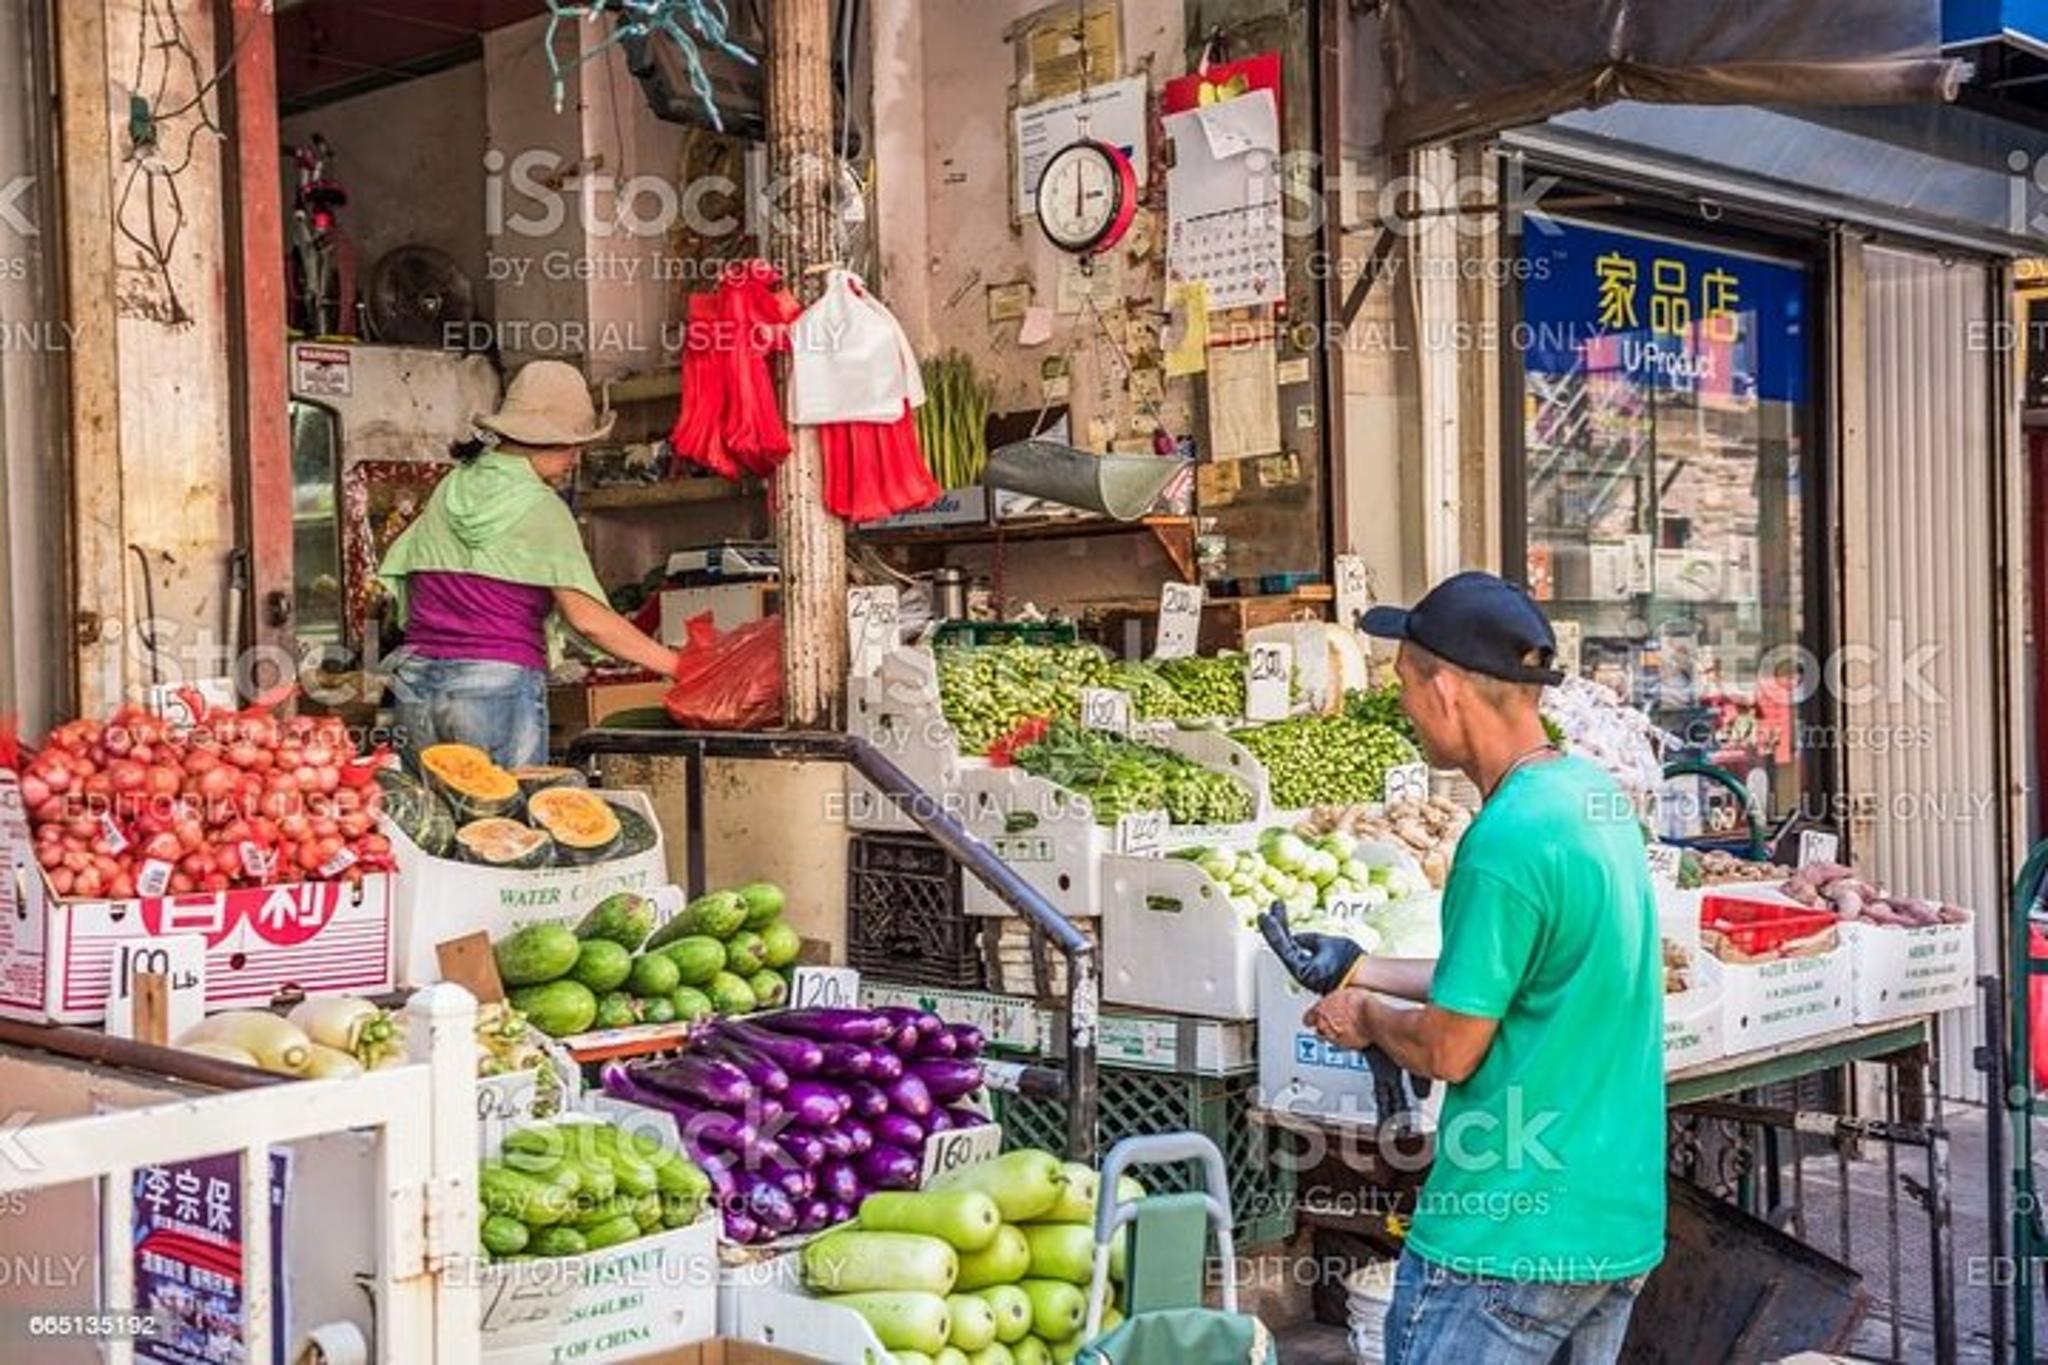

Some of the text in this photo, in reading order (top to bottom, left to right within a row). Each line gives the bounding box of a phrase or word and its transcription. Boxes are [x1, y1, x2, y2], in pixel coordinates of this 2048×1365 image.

[1595, 252, 1739, 342] 家品店
[500, 886, 562, 907] WATER
[932, 1134, 972, 1174] 160
[566, 1340, 593, 1358] OF
[594, 1327, 651, 1352] CHINA
